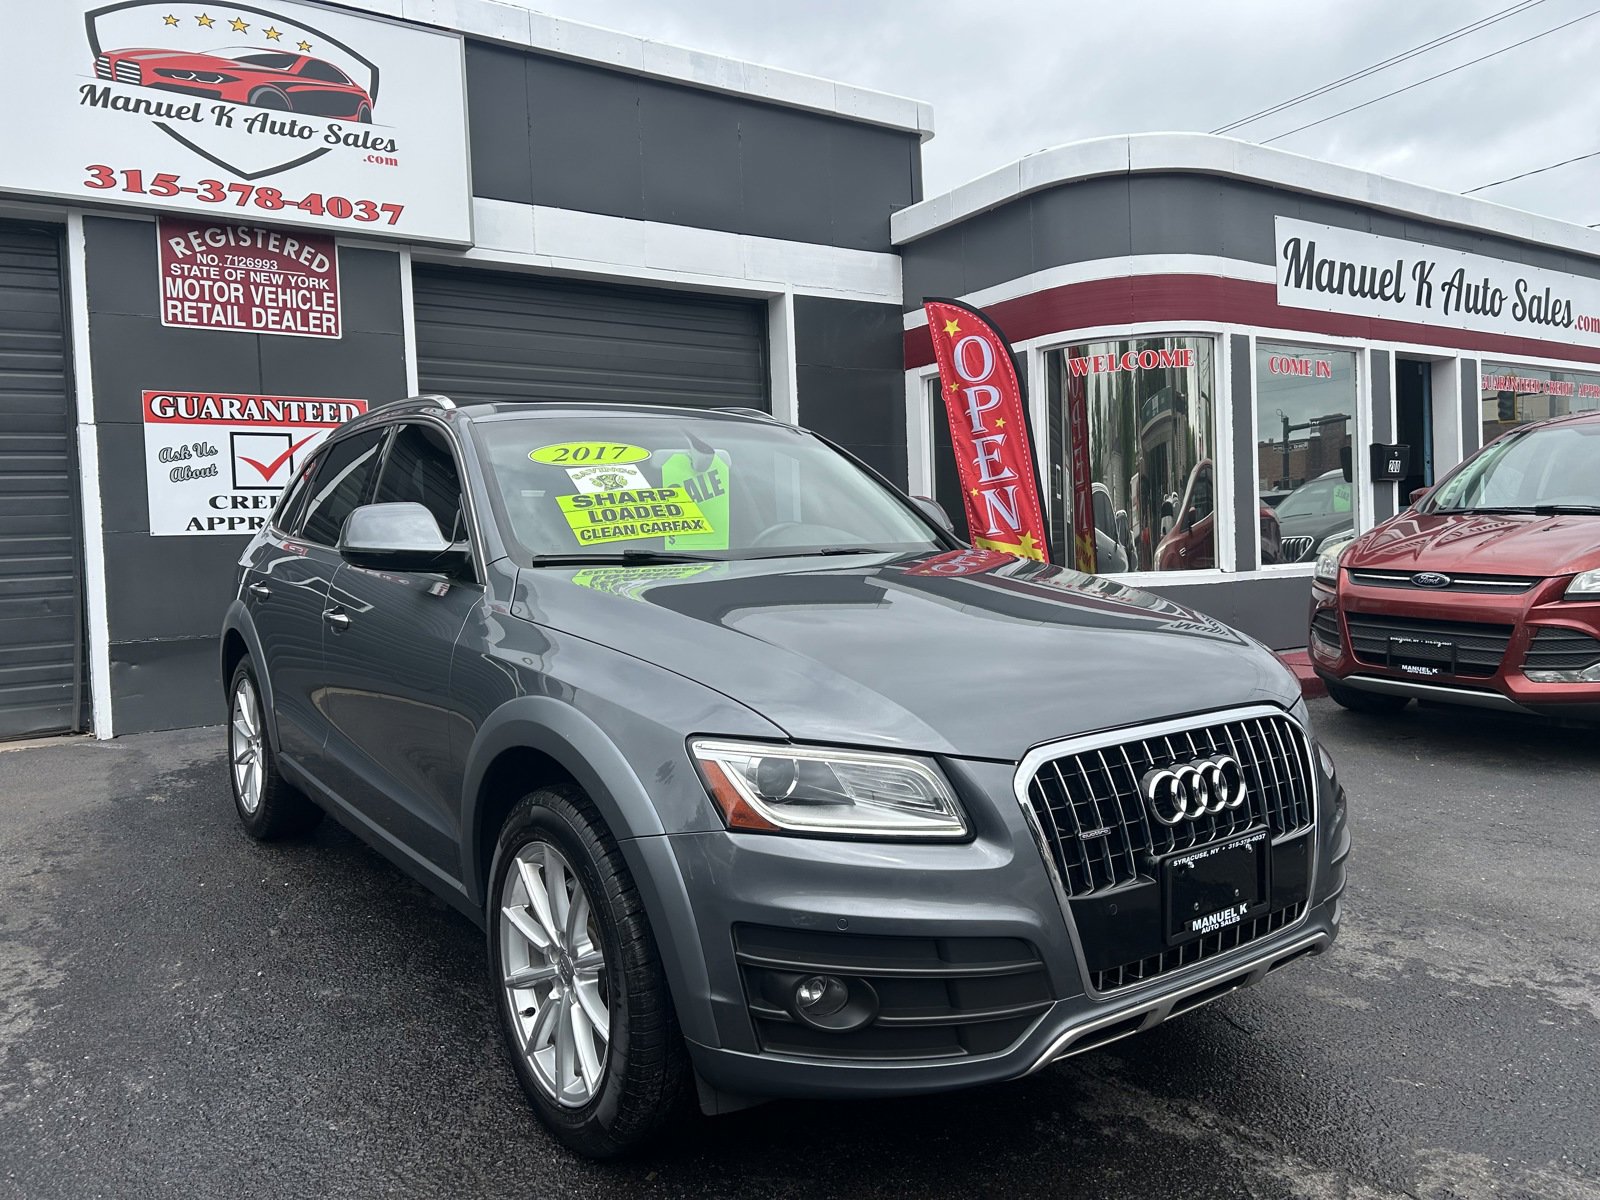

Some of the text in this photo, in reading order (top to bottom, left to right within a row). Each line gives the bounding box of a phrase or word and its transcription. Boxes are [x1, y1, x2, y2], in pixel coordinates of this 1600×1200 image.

[78, 83, 399, 153] Manuel K Auto Sales
[363, 151, 398, 167] .com
[83, 164, 404, 226] 315-378-4037
[168, 226, 330, 273] REGISTERED
[197, 253, 278, 270] NO. 7126993
[170, 263, 330, 290] STATE OF NEW YORK
[1283, 237, 1406, 304] Manuel
[1412, 260, 1436, 309] K
[1441, 268, 1508, 318] Auto
[1512, 279, 1574, 329] Sales
[166, 277, 335, 312] MOTOR VEHICLE
[166, 300, 336, 334] RETAIL DEALER
[1069, 349, 1195, 378] WELCOME
[1269, 355, 1332, 379] COME IN
[150, 396, 361, 423] GUARANTEED
[954, 335, 1021, 538] OPEN
[158, 442, 218, 463] Ask Us
[552, 446, 629, 462] 2017
[169, 463, 218, 483] About
[667, 469, 725, 503] ALE
[572, 489, 678, 508] SHARP
[588, 504, 682, 523] LOADED
[579, 519, 704, 541] CLEAN CARFAX
[1210, 847, 1220, 855] NY
[1192, 903, 1247, 931] MANUEL K
[1201, 915, 1240, 934] AUTO SALES
